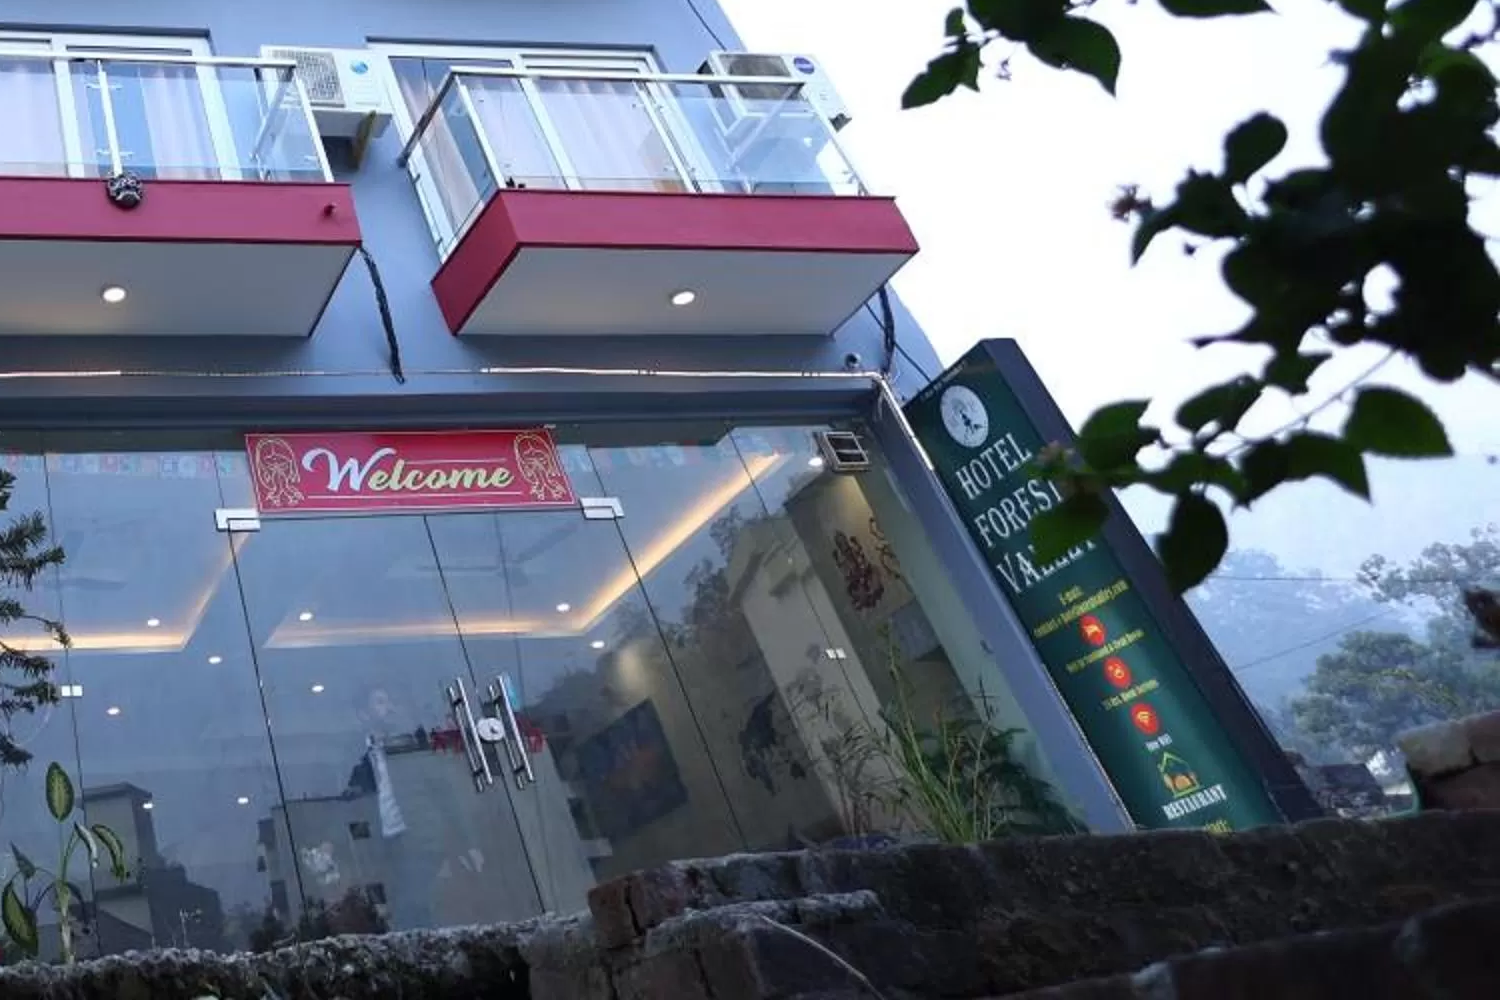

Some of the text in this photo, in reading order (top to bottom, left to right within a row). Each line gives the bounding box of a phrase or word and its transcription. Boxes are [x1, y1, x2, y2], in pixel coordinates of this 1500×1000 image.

[301, 447, 517, 493] Welcome
[955, 432, 1033, 500] HOTEL
[1161, 783, 1228, 821] RESTAURANT
